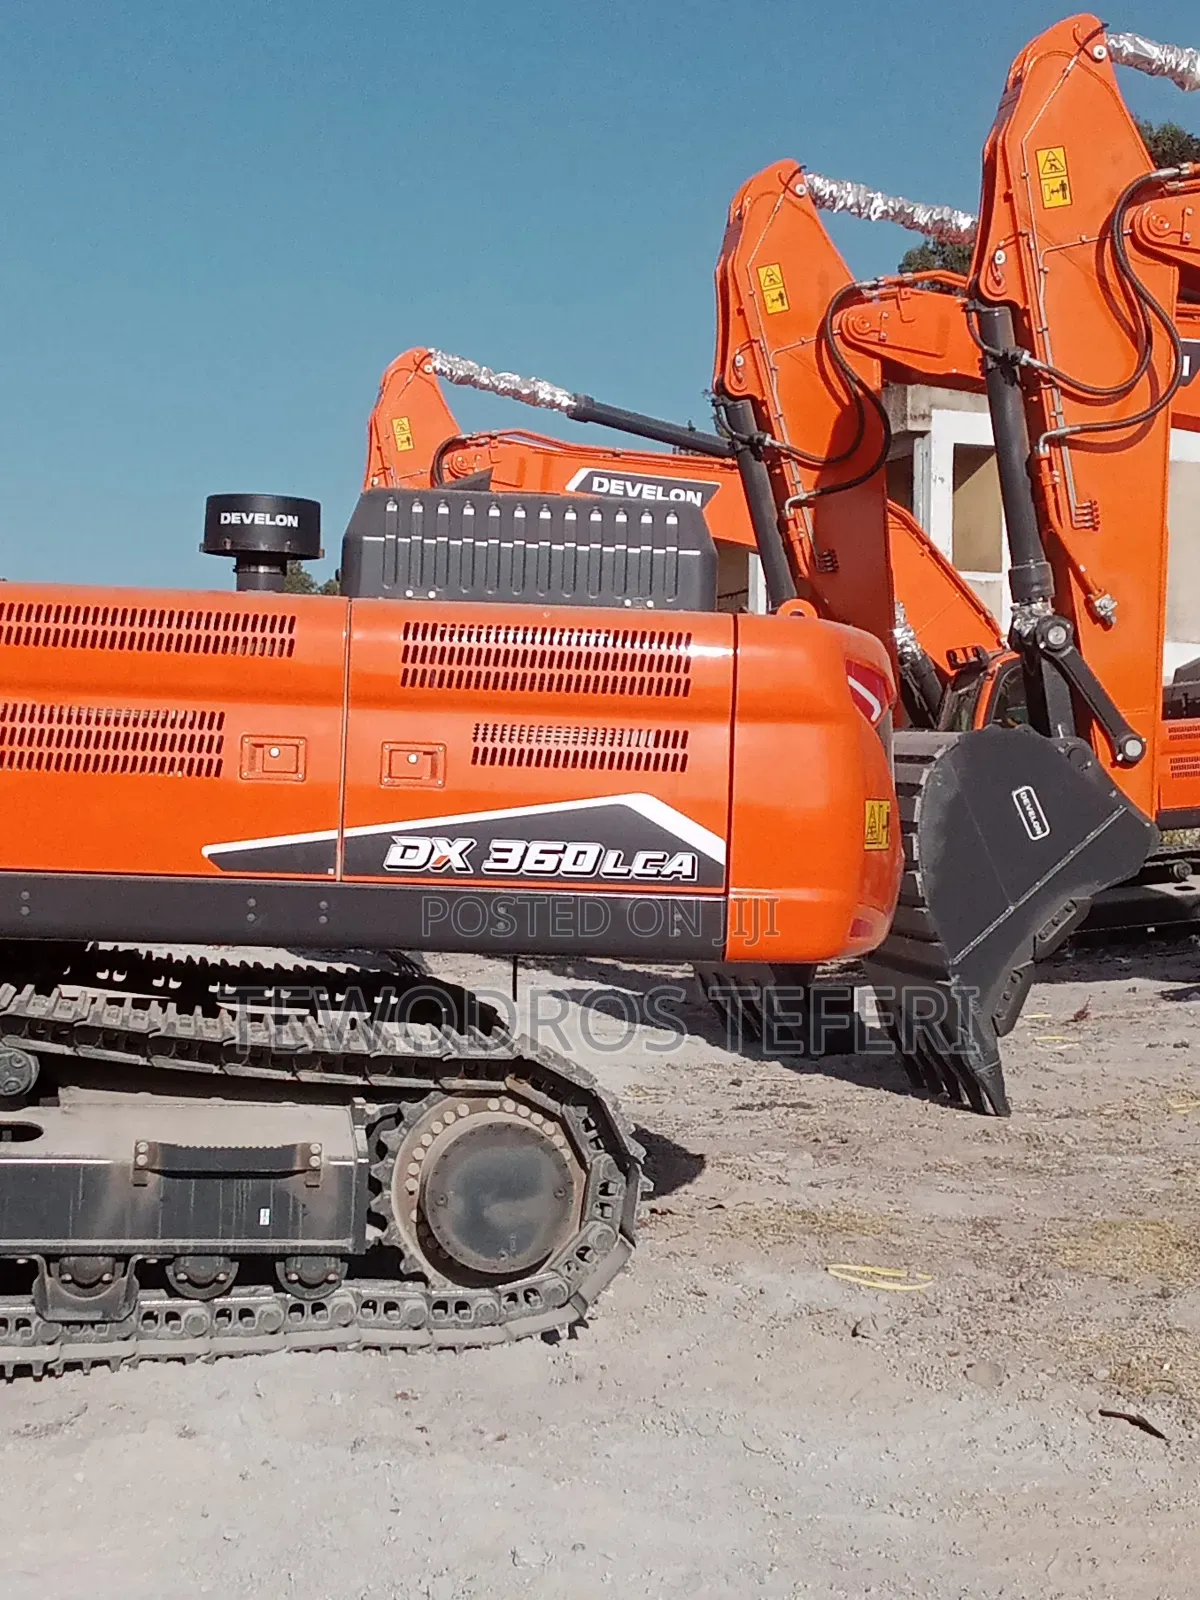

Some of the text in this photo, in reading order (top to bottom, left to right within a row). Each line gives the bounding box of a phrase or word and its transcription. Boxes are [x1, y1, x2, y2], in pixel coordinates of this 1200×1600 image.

[591, 477, 704, 506] DEVELON
[220, 511, 299, 529] DEVELON
[1019, 791, 1044, 836] DEVELON
[384, 835, 476, 873] DX
